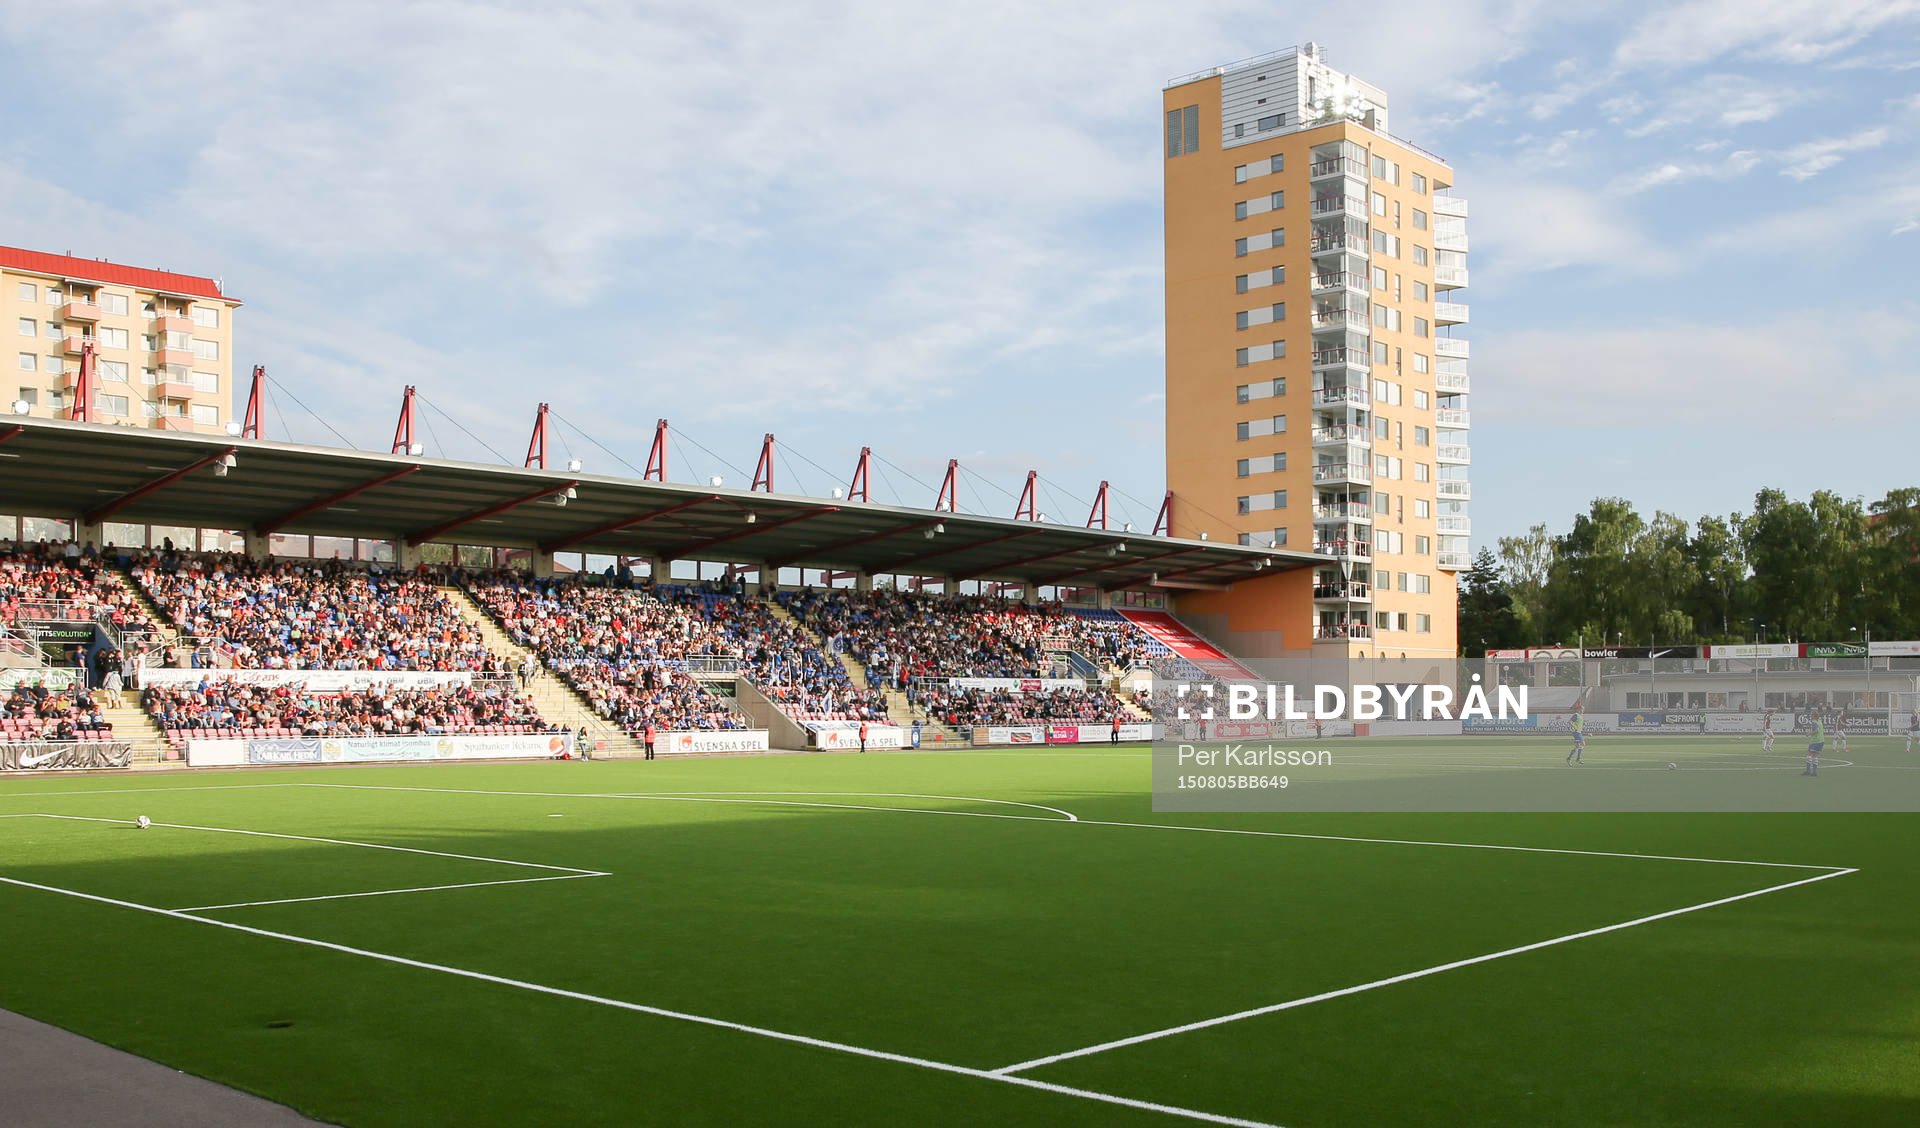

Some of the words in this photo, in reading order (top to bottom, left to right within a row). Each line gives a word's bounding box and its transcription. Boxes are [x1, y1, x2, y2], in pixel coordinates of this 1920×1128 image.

[1584, 649, 1618, 657] bowler
[1814, 647, 1836, 655] INVID
[1843, 646, 1866, 654] INVID
[1845, 716, 1889, 726] stadium
[694, 742, 737, 751] SVENSKA
[740, 740, 762, 750] SPEL
[838, 738, 876, 747] SVENKA
[879, 738, 898, 746] SPEL
